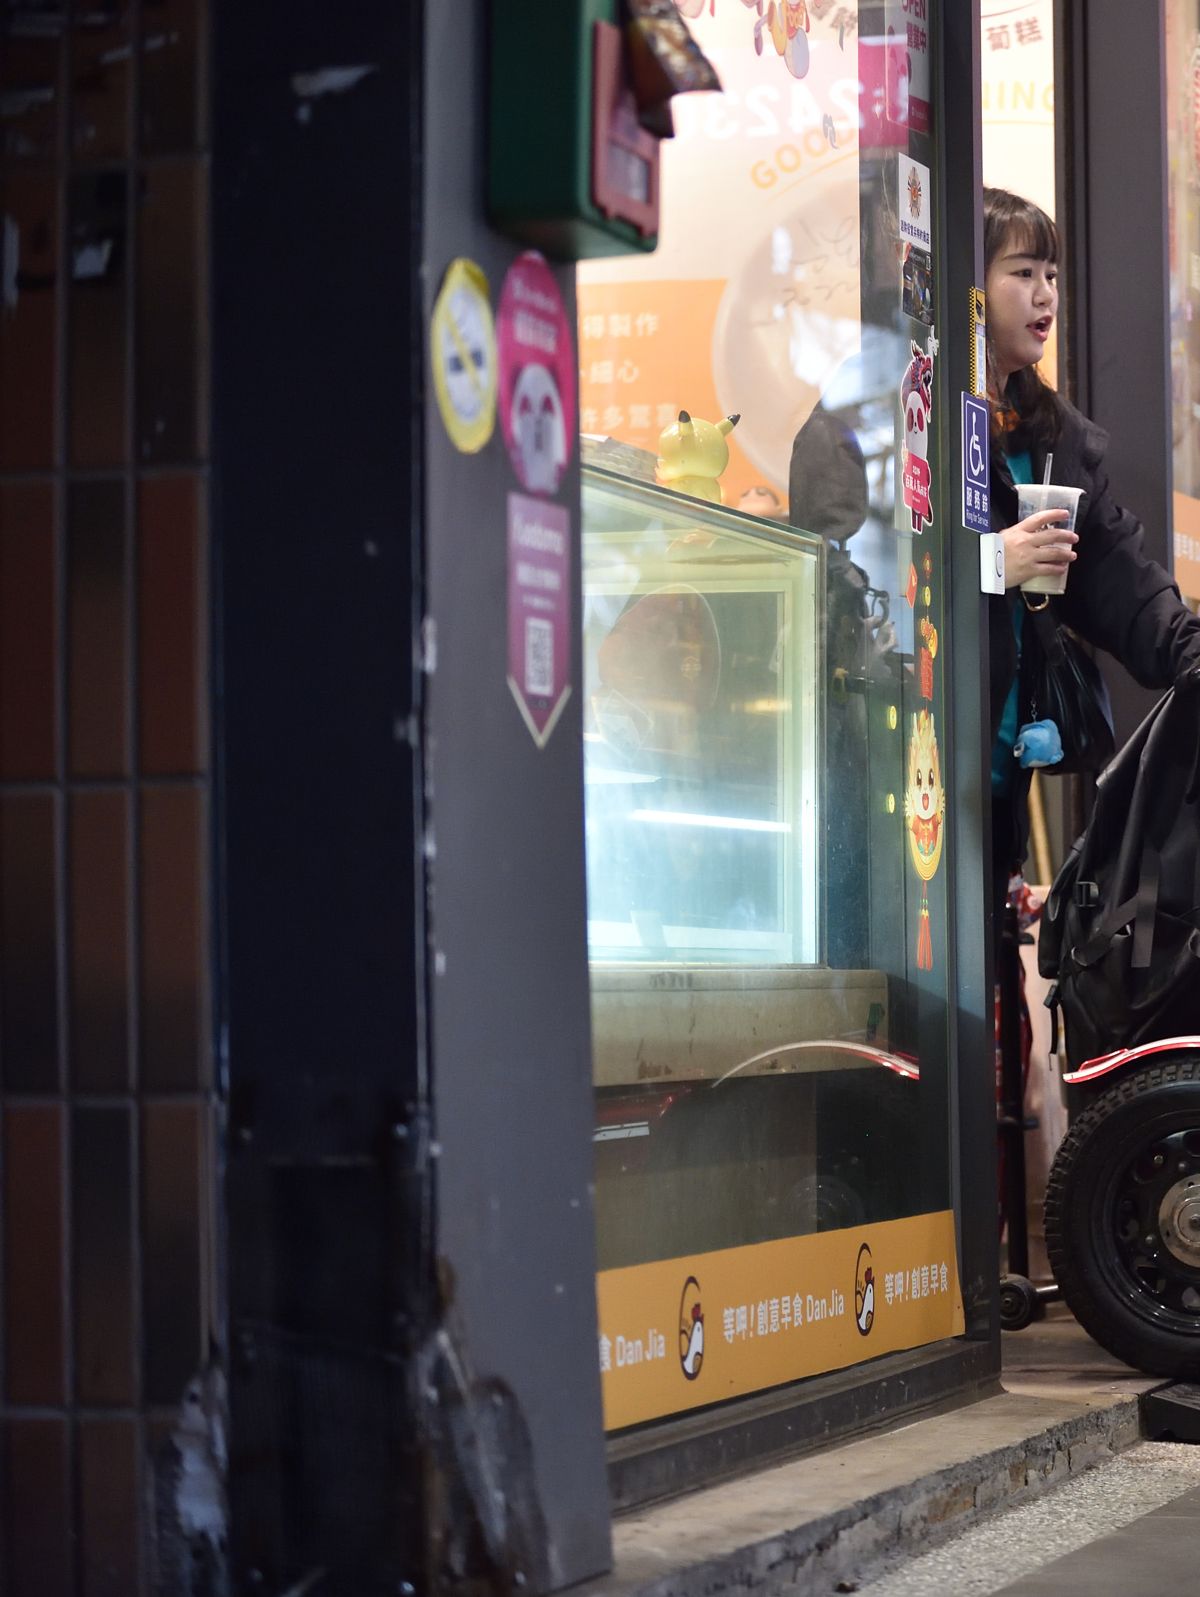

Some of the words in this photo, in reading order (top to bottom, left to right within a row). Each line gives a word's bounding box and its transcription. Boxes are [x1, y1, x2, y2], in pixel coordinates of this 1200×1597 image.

[966, 486, 988, 513] 服務鈴
[806, 1297, 828, 1323] Dan
[828, 1292, 845, 1318] Jia
[616, 1335, 643, 1367] Dan
[645, 1328, 666, 1361] Jia
